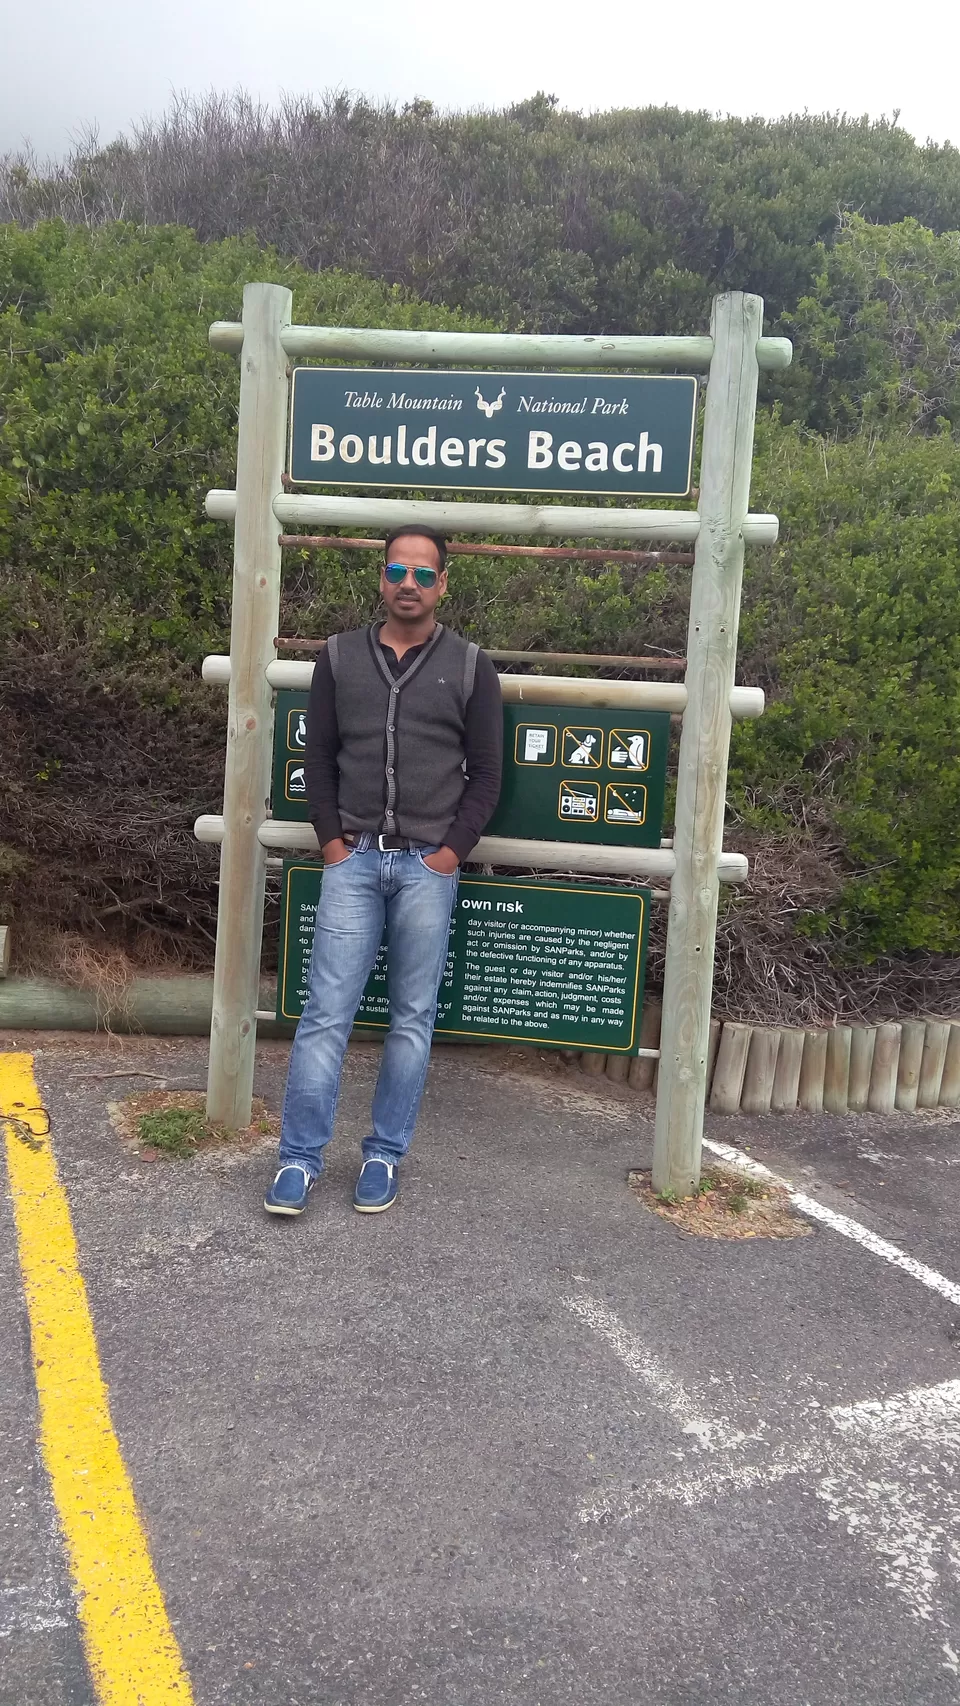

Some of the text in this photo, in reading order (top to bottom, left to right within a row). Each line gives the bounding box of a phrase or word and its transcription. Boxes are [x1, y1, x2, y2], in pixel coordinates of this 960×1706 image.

[344, 391, 629, 415] Table Mountain National Park
[310, 424, 662, 473] Boulders Beach
[300, 904, 319, 912] SAN
[462, 899, 491, 911] own
[496, 900, 524, 914] risk
[468, 918, 482, 928] day
[484, 920, 506, 928] visitor
[508, 921, 519, 930] (or
[520, 924, 576, 936] accompanying
[577, 928, 602, 938] minor)
[604, 930, 636, 940] whether
[488, 930, 516, 940] injuries
[534, 935, 562, 944] caused
[565, 937, 575, 946] by
[578, 938, 590, 946] the
[593, 940, 629, 950] negligent
[466, 949, 478, 957] the
[480, 950, 514, 961] defective
[516, 953, 557, 966] functioning
[568, 959, 582, 968] any
[584, 961, 624, 971] apparatus.
[493, 942, 527, 951] omission
[531, 944, 540, 954] by
[544, 945, 586, 957] SANParks,
[590, 950, 615, 959] and/or
[618, 952, 628, 962] by
[464, 972, 626, 995] their estate hereby indemnifies SANParks
[465, 962, 480, 971] The
[522, 967, 537, 977] day
[541, 970, 564, 978] visitor
[568, 972, 594, 981] and/or
[597, 974, 627, 984] his/her/
[377, 997, 390, 1005] any
[464, 984, 491, 993] against
[494, 987, 508, 996] any
[511, 987, 534, 997] claim,
[534, 990, 559, 999] action,
[560, 991, 598, 1003] judgment,
[462, 1004, 490, 1013] against
[492, 1006, 531, 1017] SANParks
[562, 1014, 579, 1023] may
[581, 1014, 588, 1022] in
[590, 1017, 605, 1026] any
[607, 1018, 624, 1028] way
[463, 994, 624, 1016] and/or expenses which may be made
[462, 1013, 472, 1021] be
[473, 1015, 499, 1024] related
[510, 1018, 522, 1026] the
[524, 1020, 550, 1029] above.
